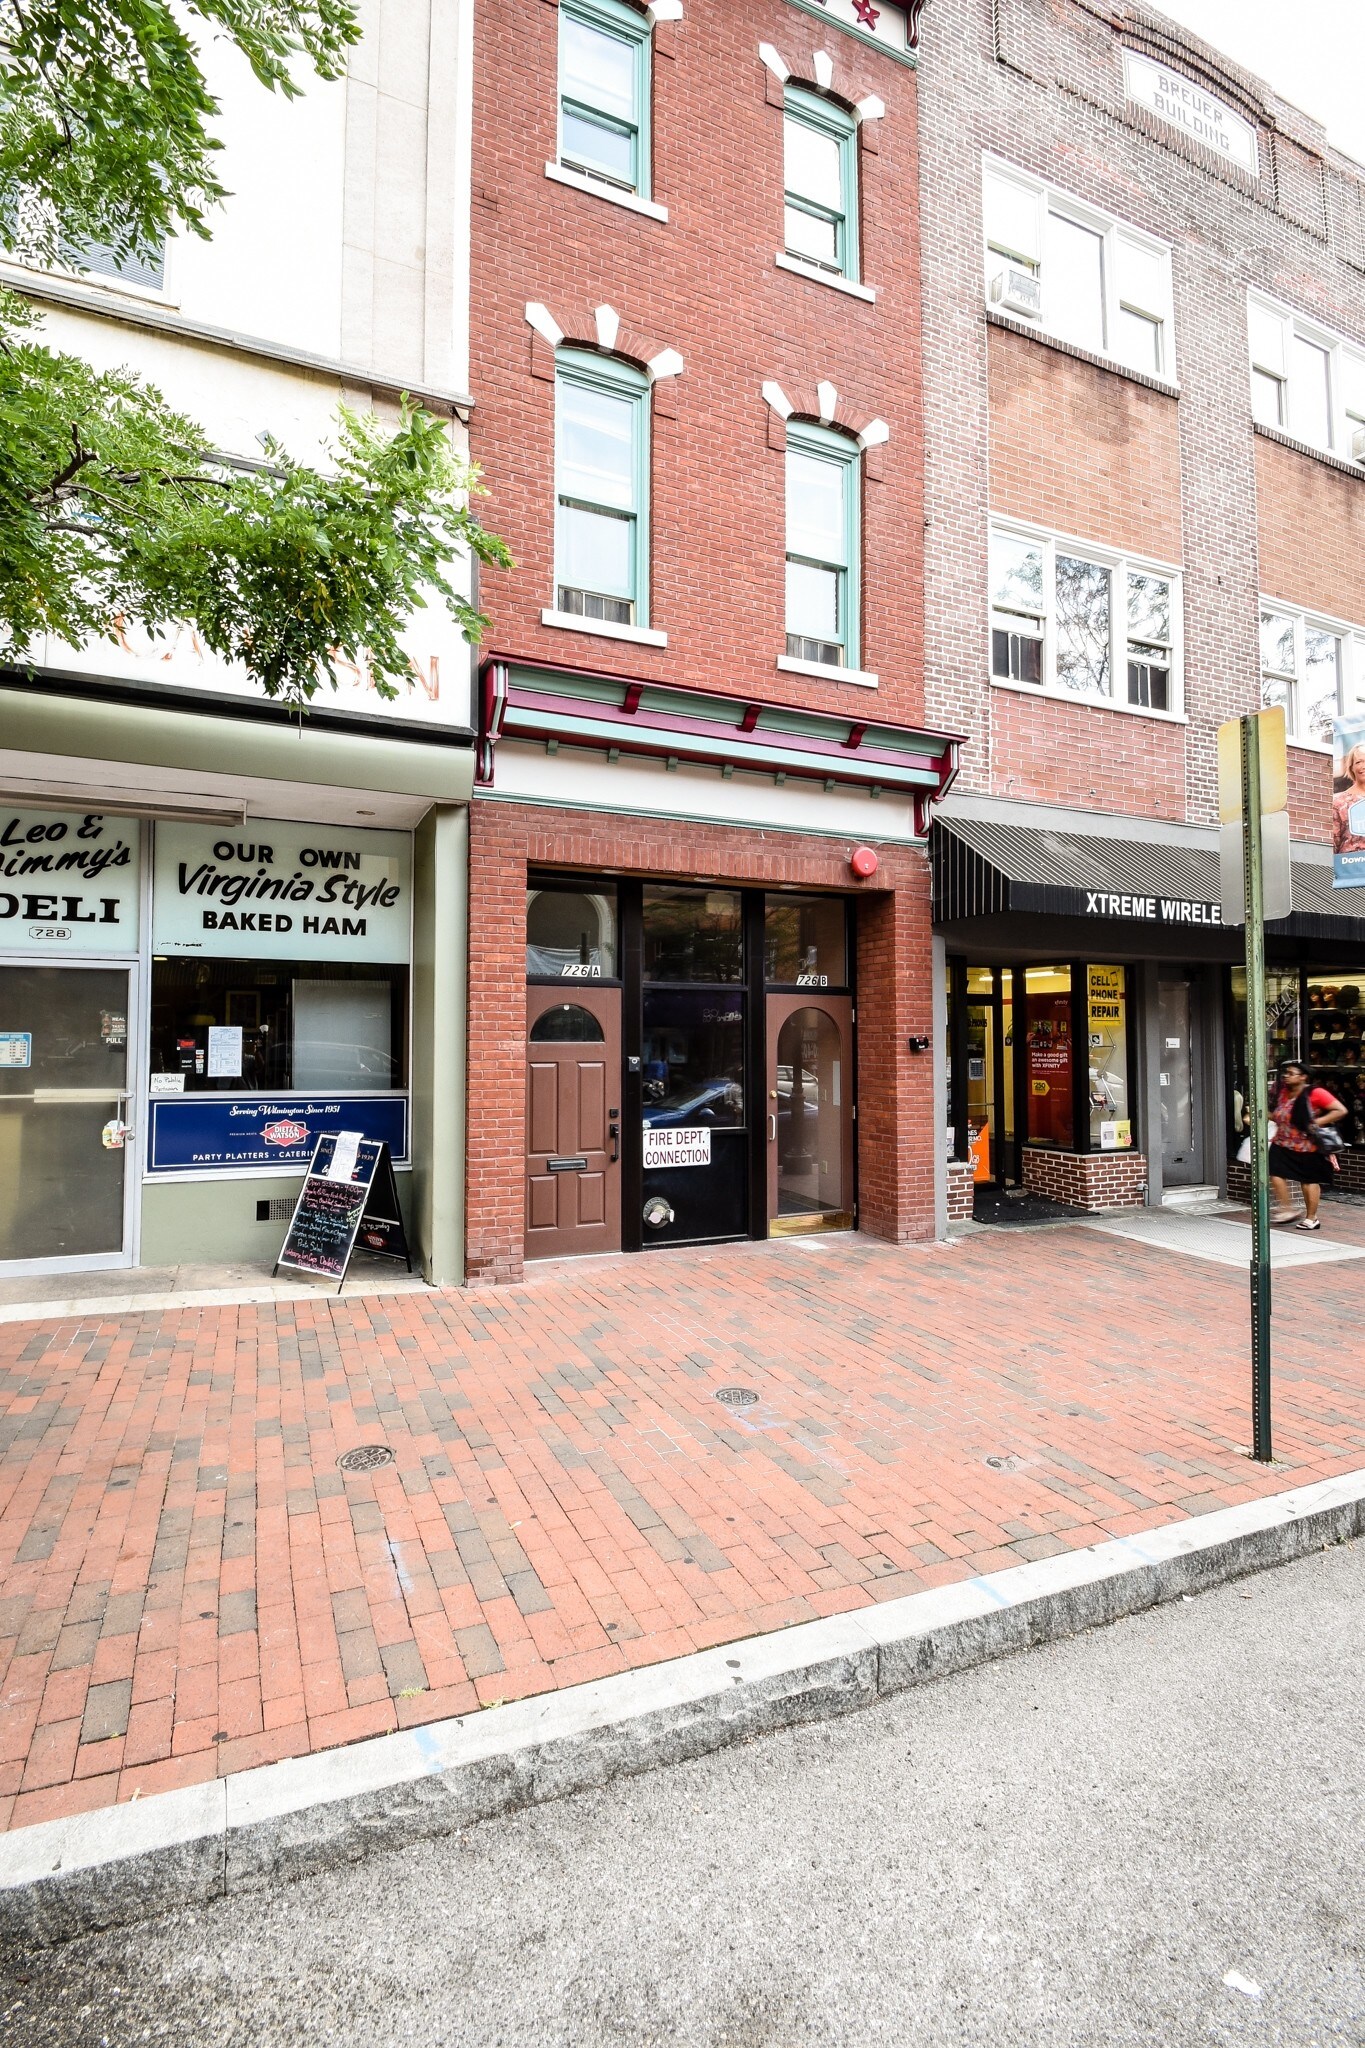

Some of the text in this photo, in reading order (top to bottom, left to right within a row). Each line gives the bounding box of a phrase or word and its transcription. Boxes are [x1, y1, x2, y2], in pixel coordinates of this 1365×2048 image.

[1157, 74, 1223, 126] BREUER
[1153, 91, 1230, 151] BUILDING
[0, 814, 104, 847] Leo &
[213, 841, 361, 870] OUR OWN
[178, 862, 400, 911] Virginia Style
[1086, 892, 1239, 927] XTREME WIRELE
[202, 910, 367, 936] BAKED HAM
[34, 928, 67, 938] 728
[563, 965, 589, 976] 726
[592, 966, 600, 977] A
[798, 975, 827, 986] 726 B
[1090, 975, 1111, 987] CELL
[1090, 989, 1118, 1000] PHONE
[1091, 1005, 1120, 1018] REPAIR
[1047, 1051, 1060, 1060] good
[229, 1104, 341, 1118] Serving Wilmington Since 1951
[274, 1126, 294, 1134] DIETZ
[649, 1130, 705, 1146] FIRE DEPT.
[192, 1149, 315, 1161] PARTY PLATTERS CATERIN
[645, 1149, 709, 1165] CONNECTION
[308, 1179, 320, 1187] Open
